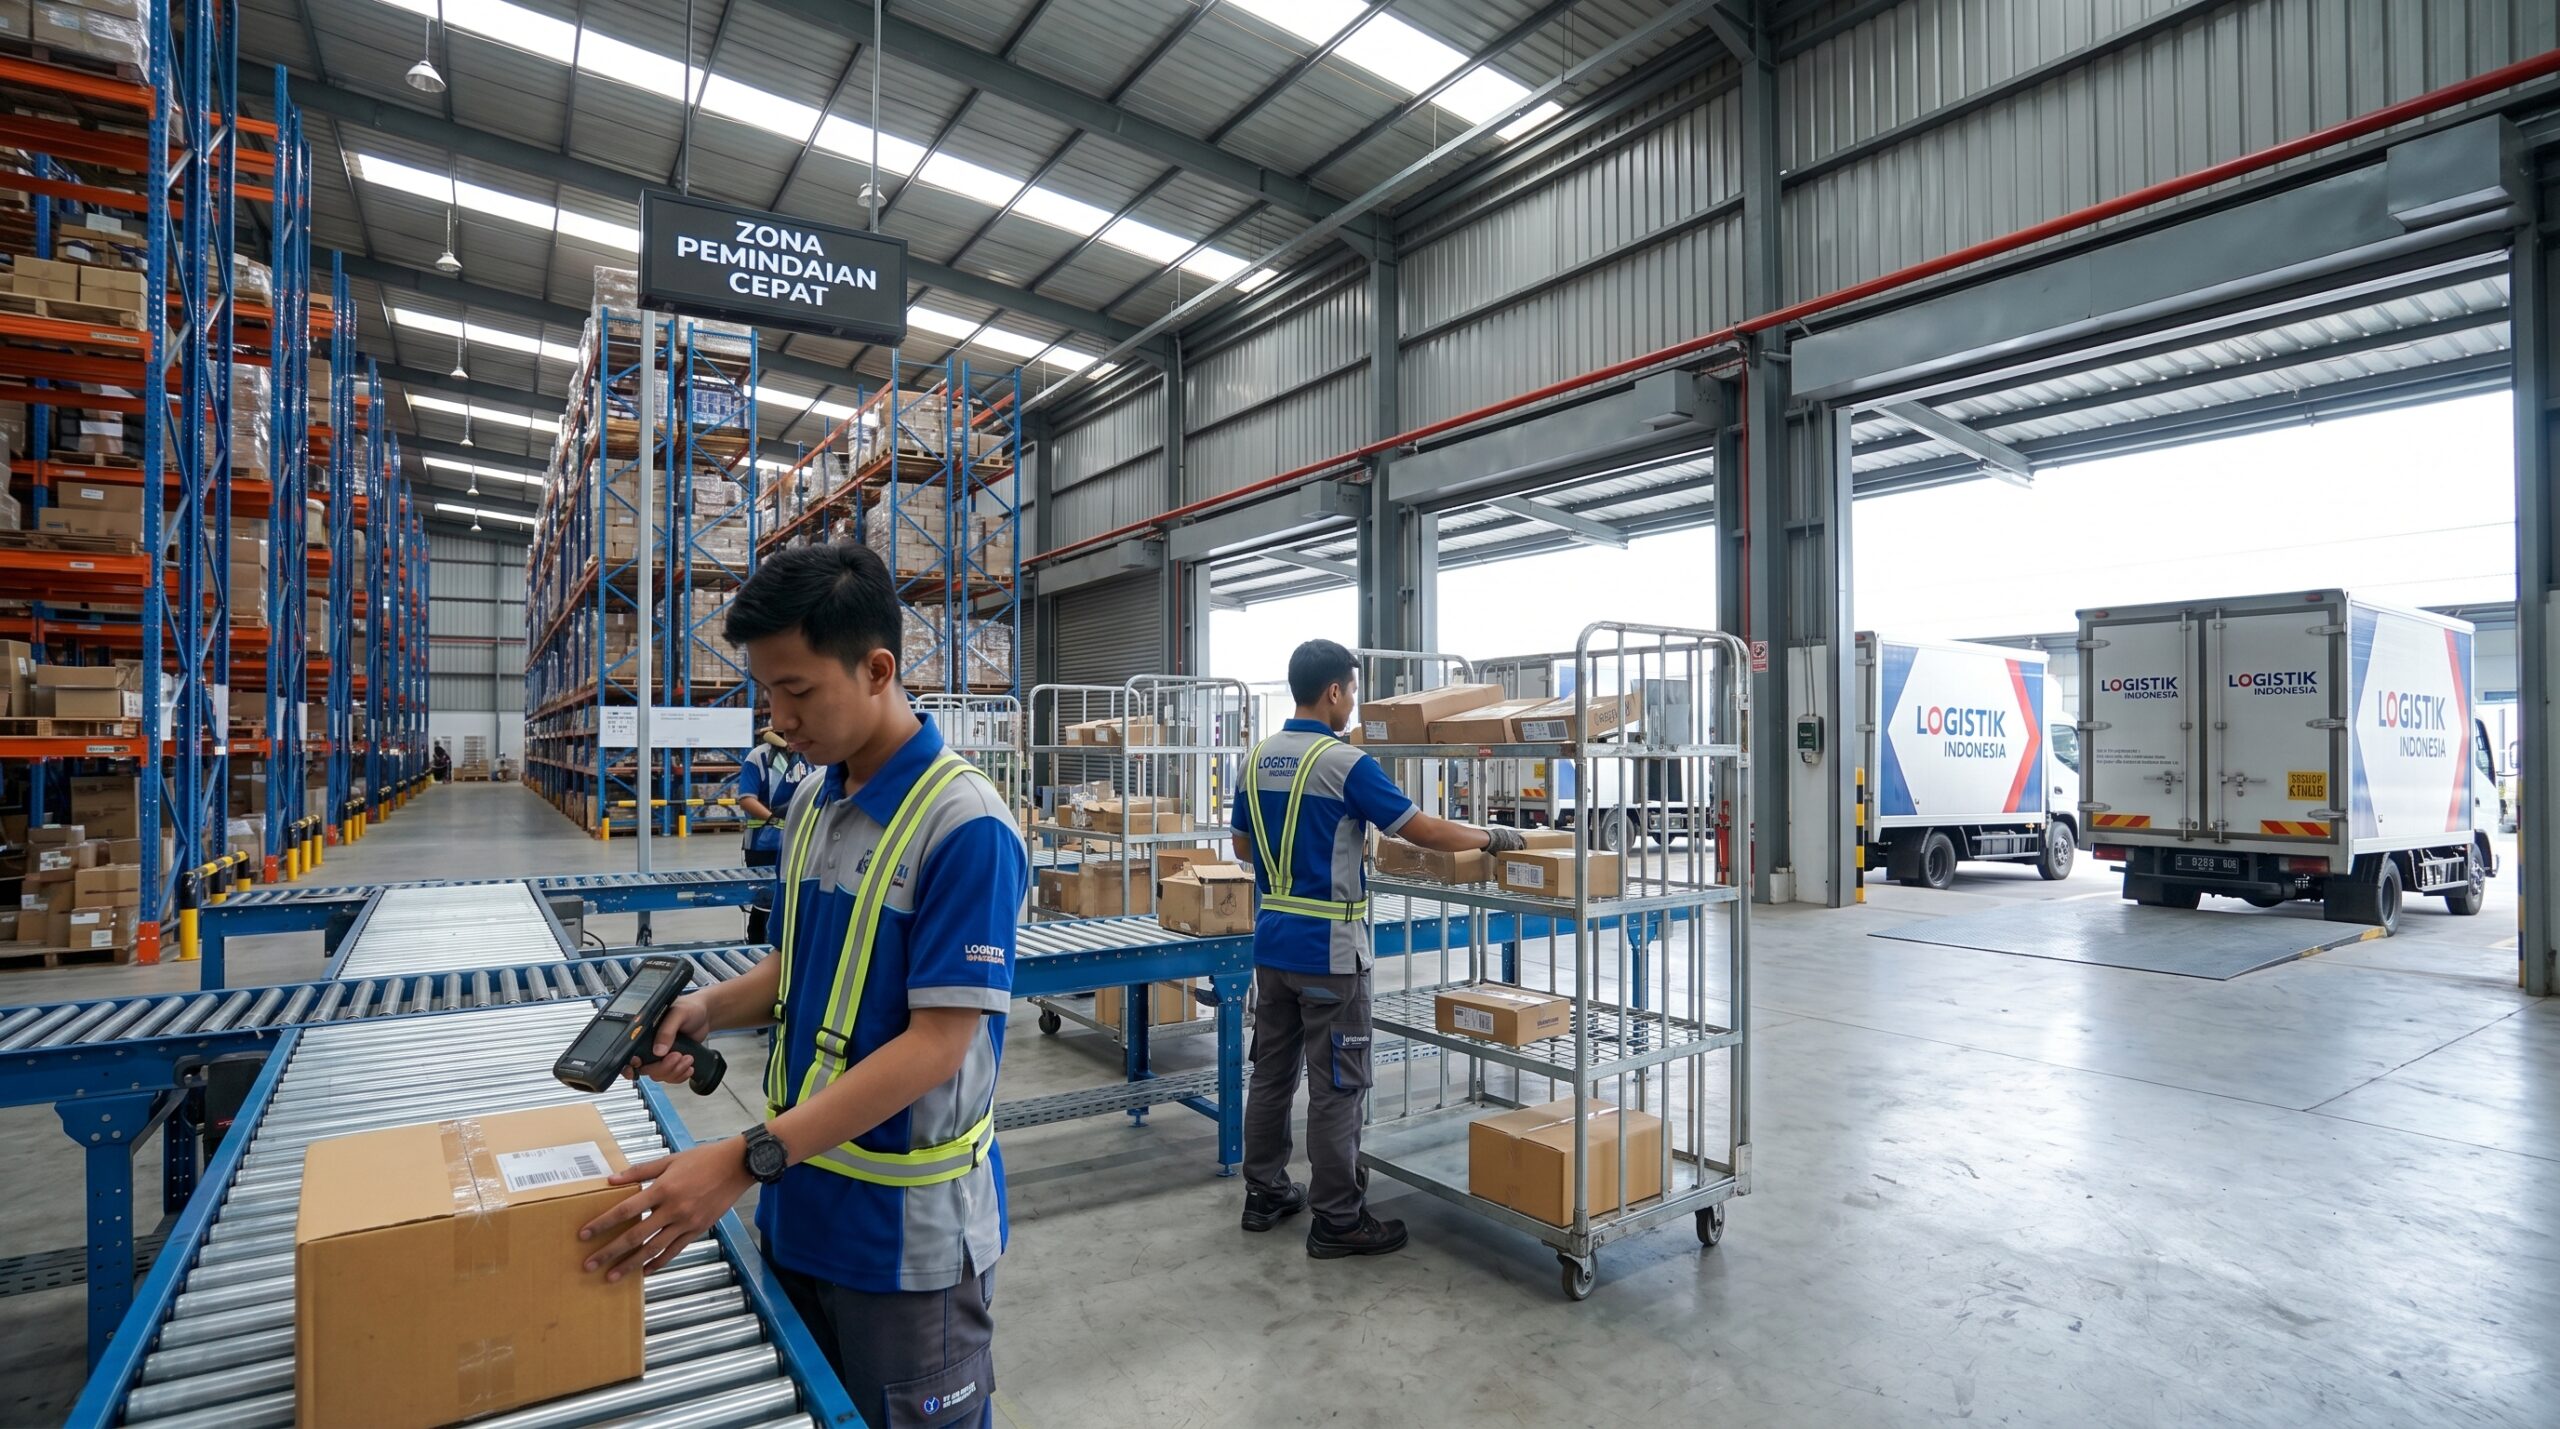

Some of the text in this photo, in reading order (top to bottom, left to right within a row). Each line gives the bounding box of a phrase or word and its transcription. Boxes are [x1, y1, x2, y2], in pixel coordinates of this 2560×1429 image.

[736, 220, 824, 257] ZONA
[677, 235, 877, 291] PEMINDAIAN
[729, 272, 829, 306] CEPAT
[2101, 676, 2178, 692] LOGISTIK
[2228, 670, 2318, 688] LOGISTIK
[2254, 686, 2318, 696] INDONESIA
[1916, 705, 2006, 738] LOGISTIK
[2378, 689, 2446, 731] LOGISTIK
[1944, 740, 2007, 759] INDONESIA
[2399, 735, 2447, 758] INDONESIA
[1258, 755, 1300, 770] LOGISTIK
